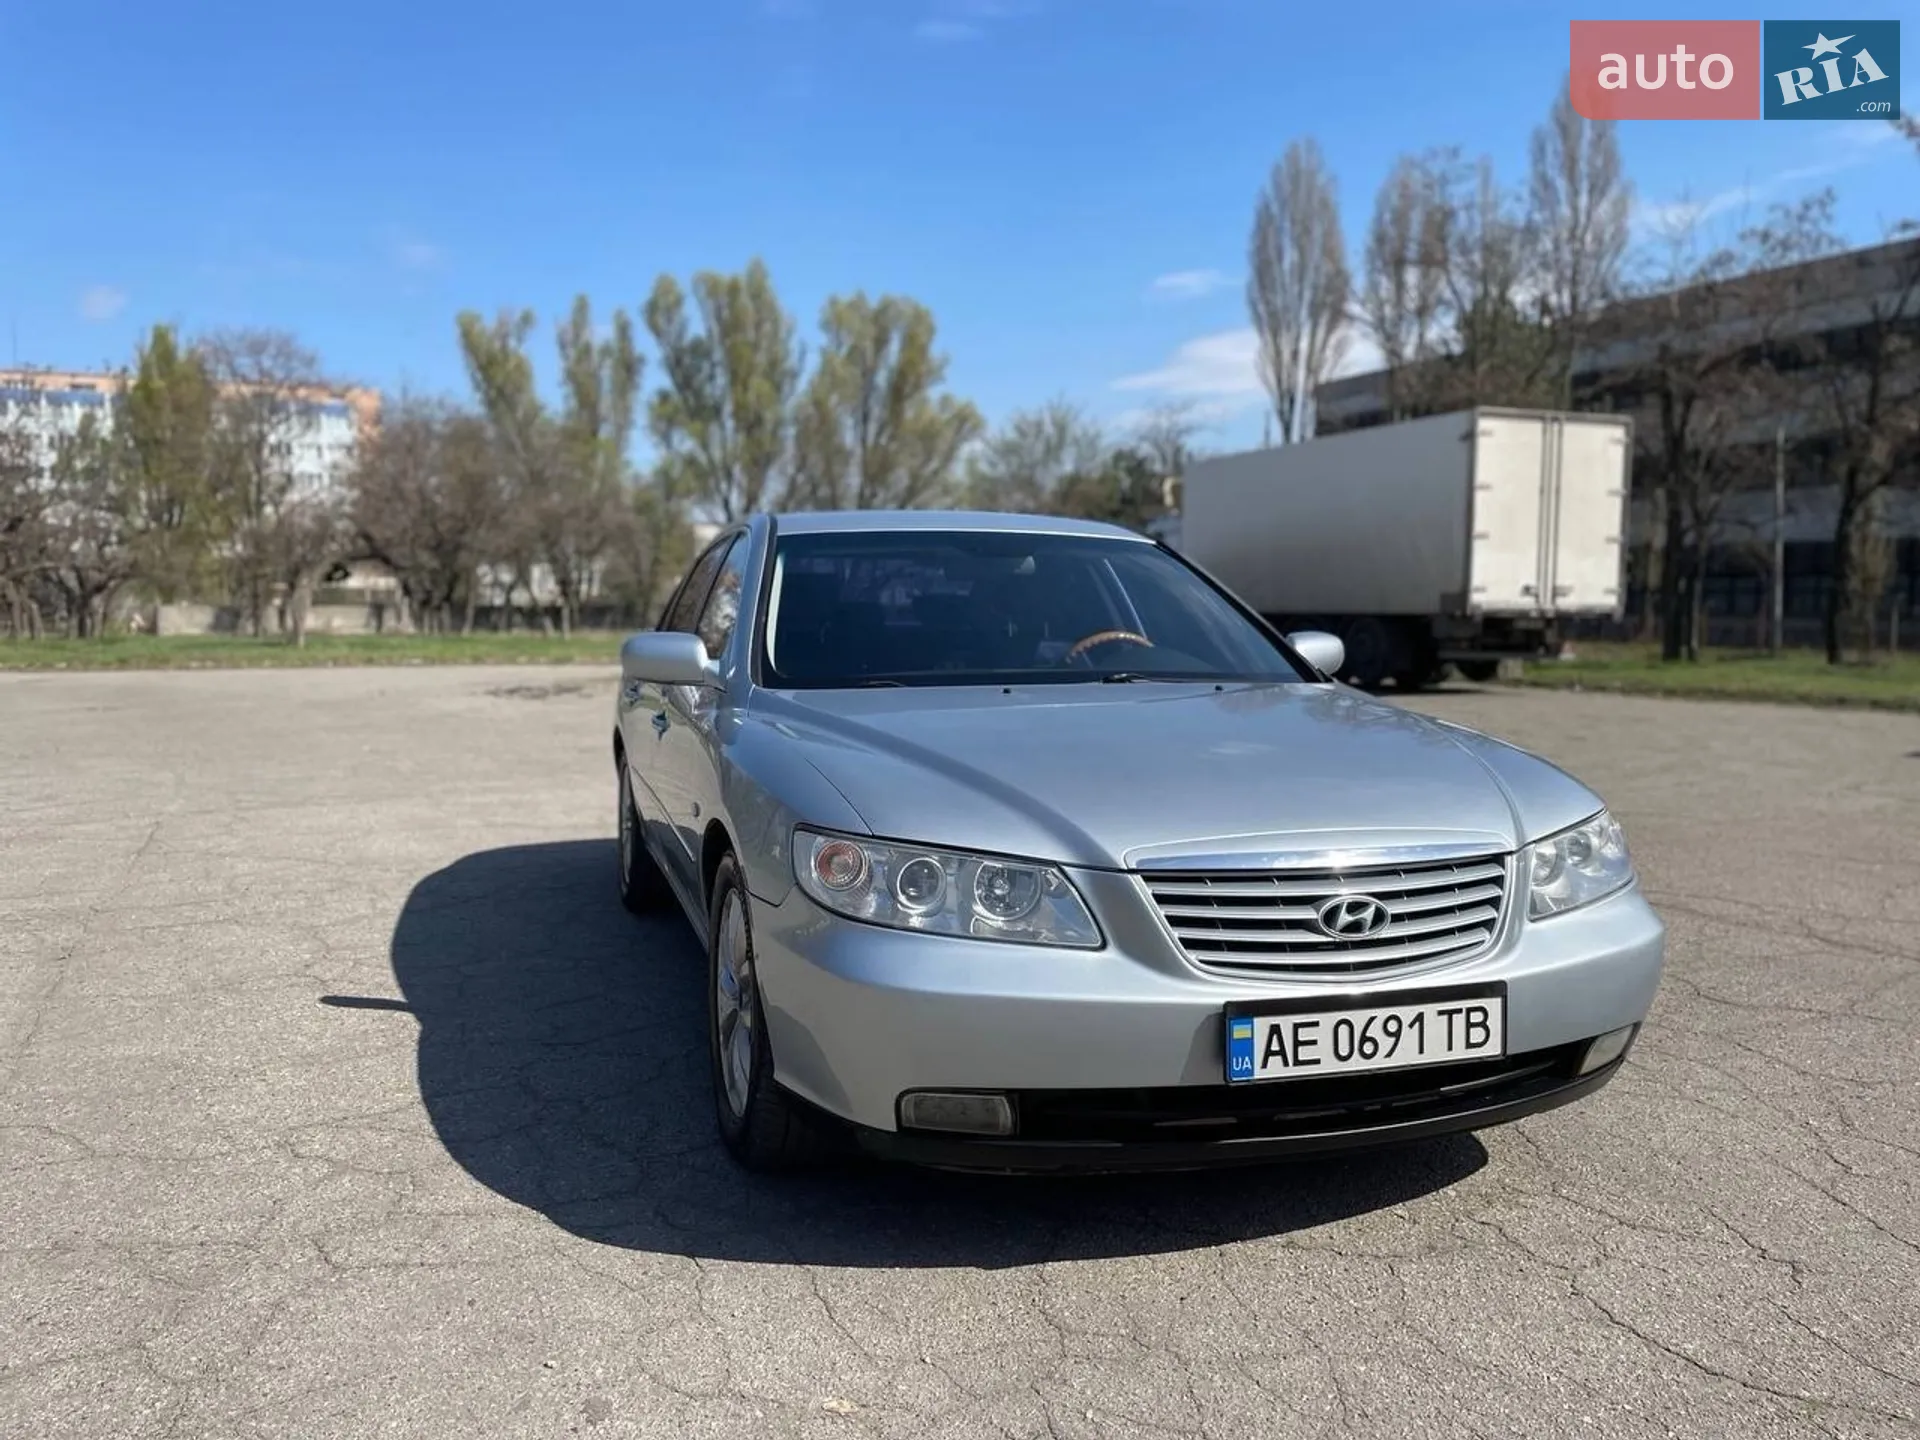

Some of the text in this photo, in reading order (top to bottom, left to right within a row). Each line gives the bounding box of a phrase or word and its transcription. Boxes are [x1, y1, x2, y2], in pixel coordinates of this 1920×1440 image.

[1260, 1005, 1491, 1069] AE 0691 TB
[1232, 1056, 1253, 1071] UA
